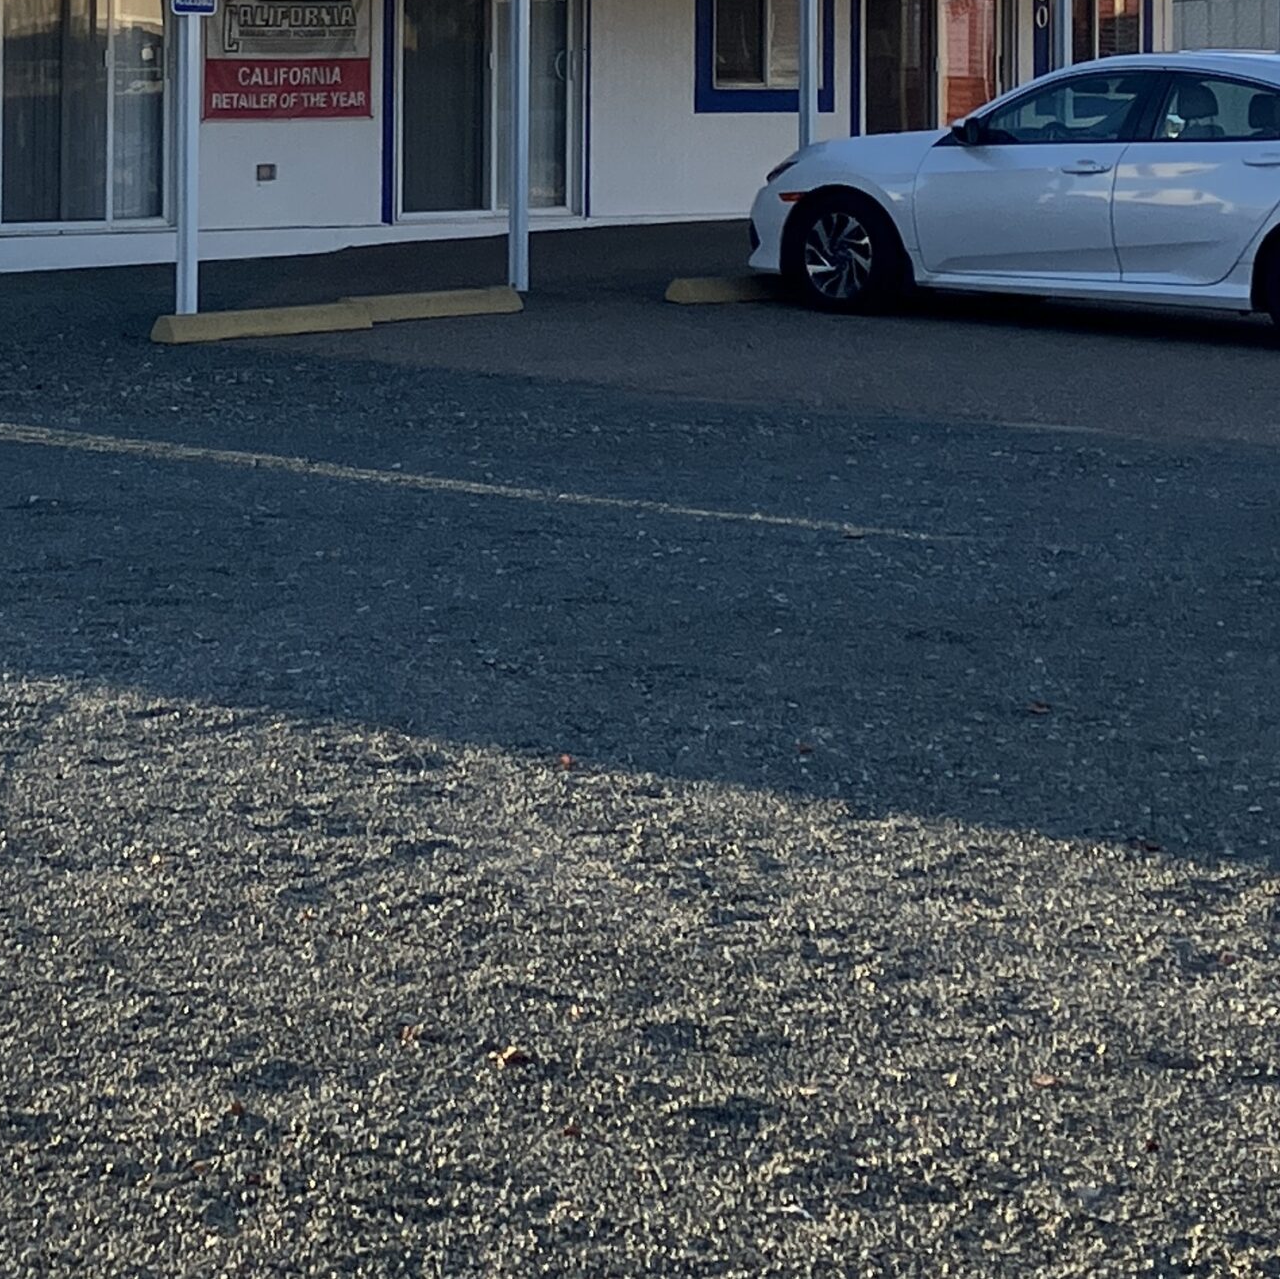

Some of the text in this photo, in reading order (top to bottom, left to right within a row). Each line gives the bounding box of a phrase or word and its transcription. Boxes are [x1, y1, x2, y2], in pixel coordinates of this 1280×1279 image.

[238, 67, 342, 86] CALIFORNIA
[212, 91, 366, 109] RETAILER OF THE YEAR
